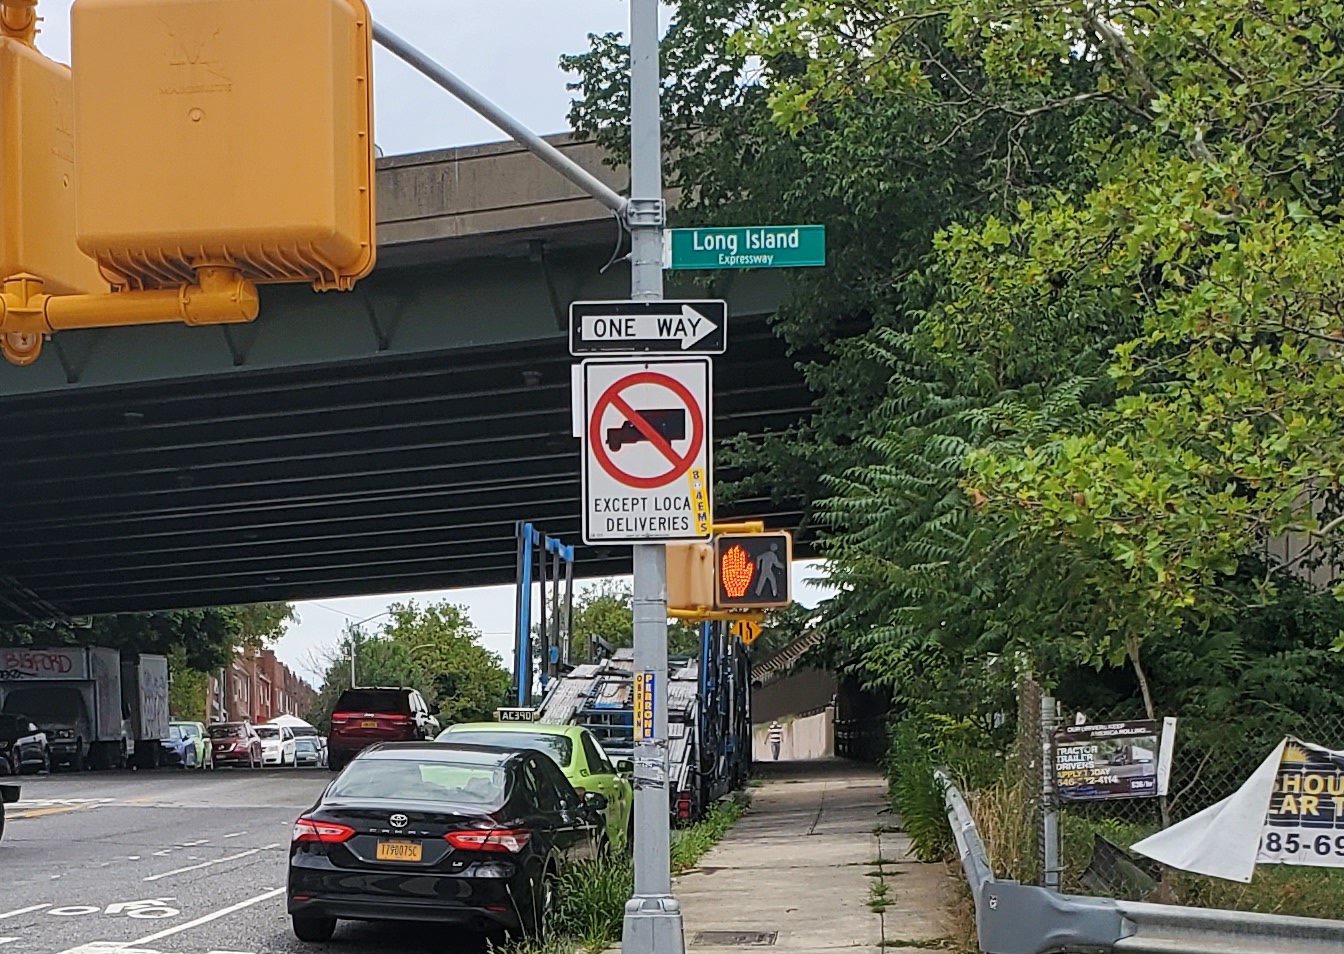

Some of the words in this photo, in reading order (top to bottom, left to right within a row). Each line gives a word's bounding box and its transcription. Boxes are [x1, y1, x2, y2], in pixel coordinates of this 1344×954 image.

[693, 231, 738, 255] Long
[746, 229, 799, 249] Island
[718, 253, 774, 266] Expressway
[593, 318, 636, 338] ONE
[657, 317, 702, 337] WAY
[594, 497, 648, 512] EXCEPT
[654, 496, 692, 511] LOCA
[606, 516, 689, 532] DELIVERIES
[643, 674, 653, 737] PERRONE
[502, 711, 531, 720] AC390
[1057, 746, 1098, 756] TRACTOR
[1057, 754, 1094, 763] TRAILER
[1056, 761, 1094, 771] DRIVERS
